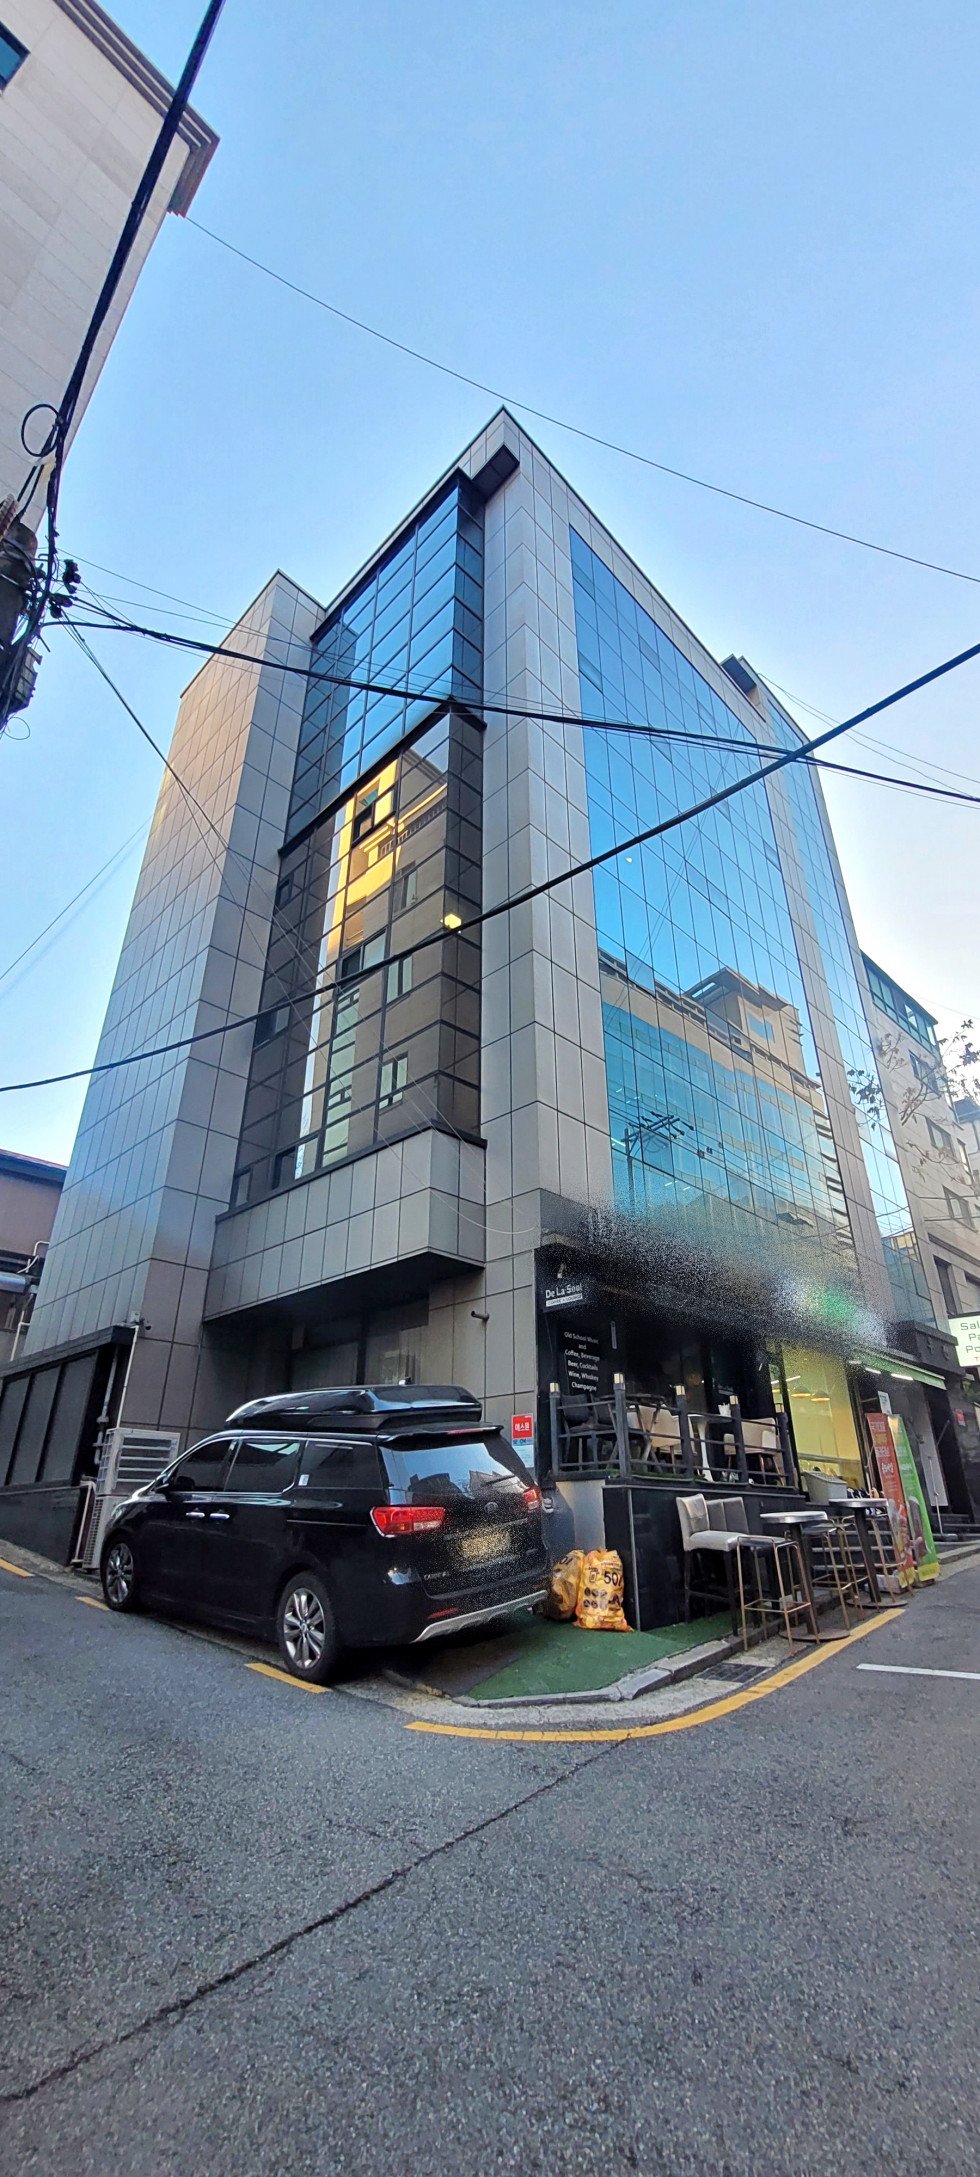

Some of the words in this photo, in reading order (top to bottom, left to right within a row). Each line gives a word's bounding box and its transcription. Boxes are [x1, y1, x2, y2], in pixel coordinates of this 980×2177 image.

[545, 1289, 555, 1298] De
[556, 1286, 565, 1296] La
[566, 1283, 582, 1293] Soul
[564, 1331, 572, 1339] Old
[572, 1333, 586, 1341] School
[565, 1349, 580, 1358] Coffee,
[581, 1352, 600, 1362] Beverage
[568, 1360, 579, 1369] Beer,
[568, 1370, 580, 1379] Wine,
[581, 1373, 598, 1382] Whiskey
[571, 1381, 597, 1391] Champagne
